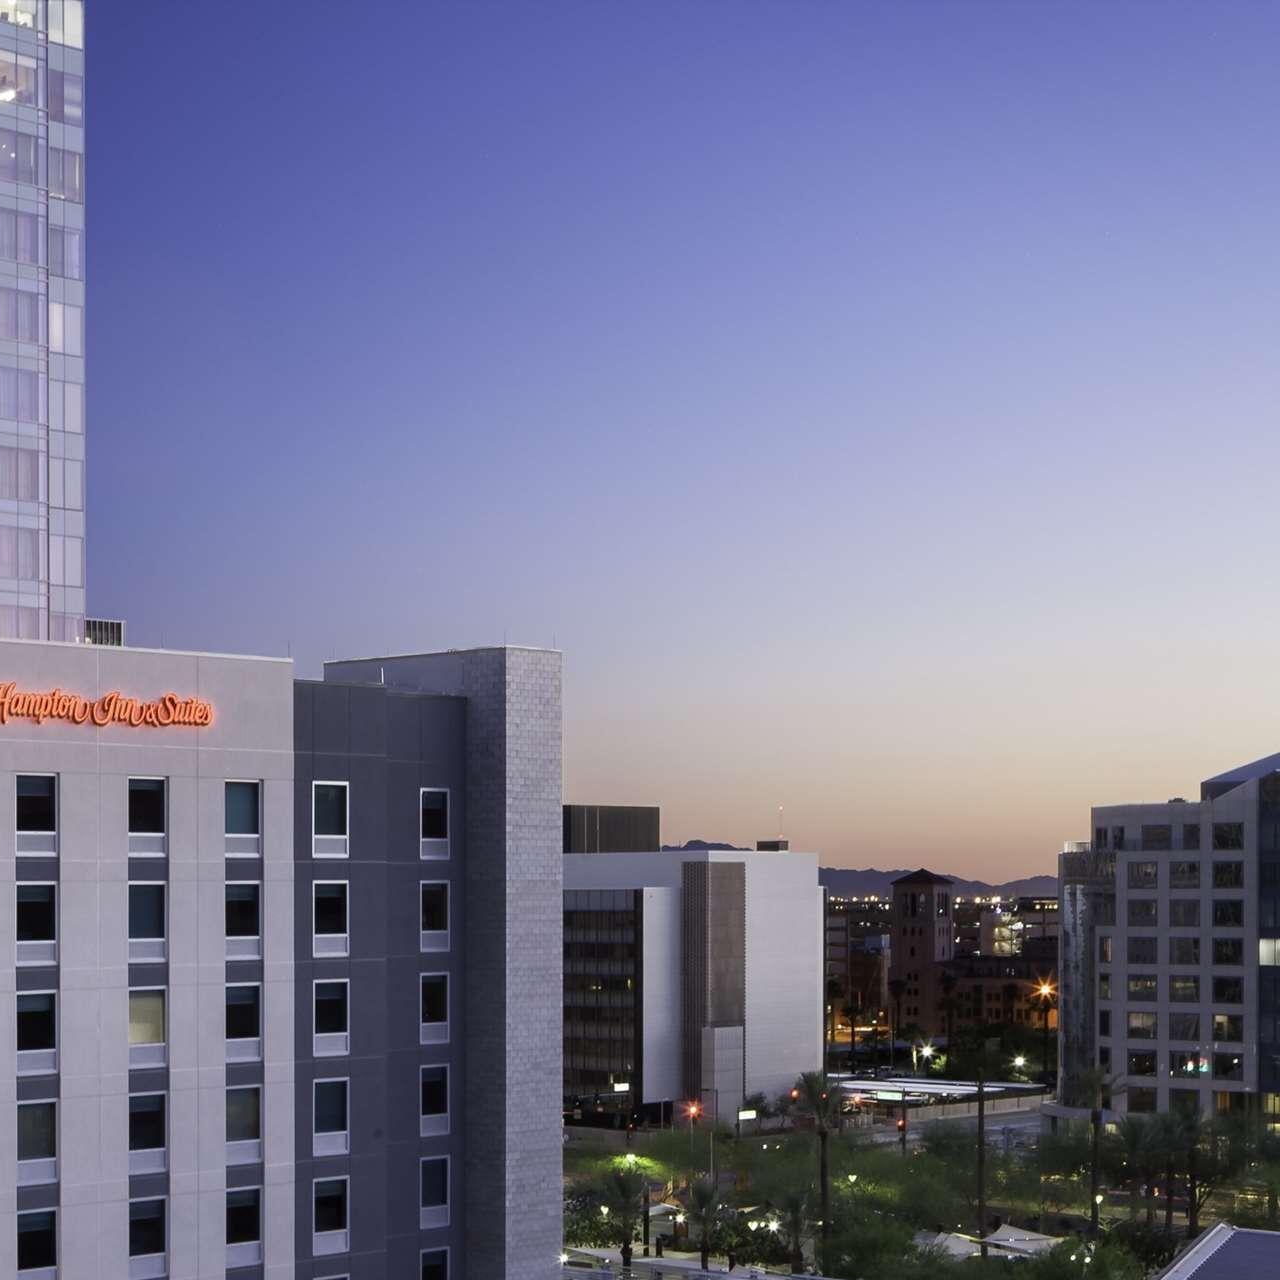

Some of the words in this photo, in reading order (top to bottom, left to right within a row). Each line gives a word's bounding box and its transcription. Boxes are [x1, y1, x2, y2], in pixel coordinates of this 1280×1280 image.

[92, 690, 147, 726] Inn
[146, 704, 160, 727] &
[157, 694, 213, 726] Suites
